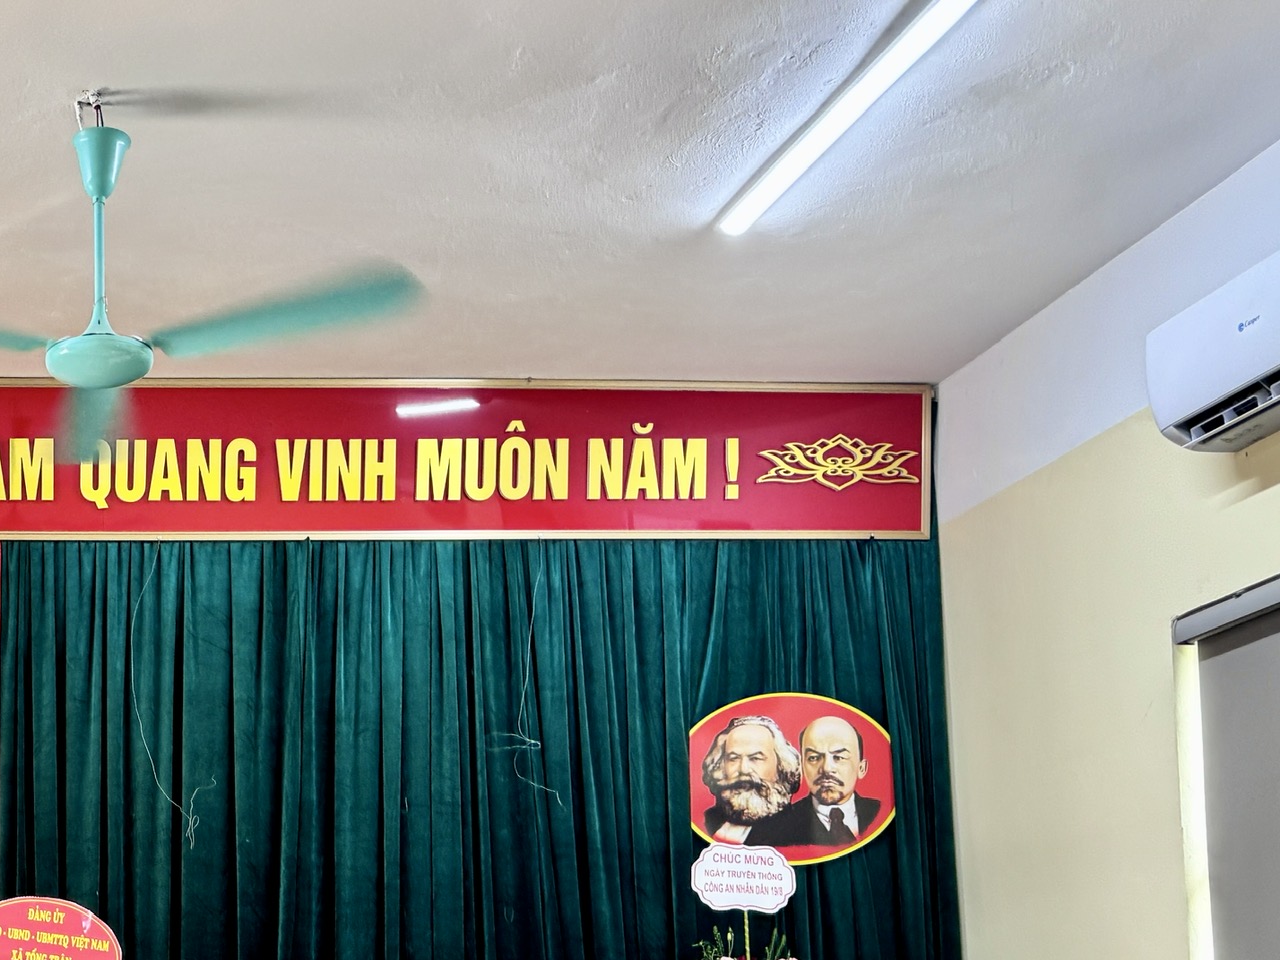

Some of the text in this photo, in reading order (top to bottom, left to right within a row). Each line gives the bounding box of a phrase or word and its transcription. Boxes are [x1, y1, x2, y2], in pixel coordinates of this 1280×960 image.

[79, 438, 257, 510] QUANG
[275, 438, 397, 502] VINH
[415, 419, 570, 501] MUÔN
[587, 423, 708, 501] NĂM
[726, 437, 740, 499] !
[713, 851, 774, 867] CHÚC MỪNG
[725, 883, 734, 893] AN
[7, 928, 31, 941] UBND
[36, 931, 69, 949] UBMTTQ
[71, 935, 91, 951] VIỆT
[91, 939, 110, 952] NAM
